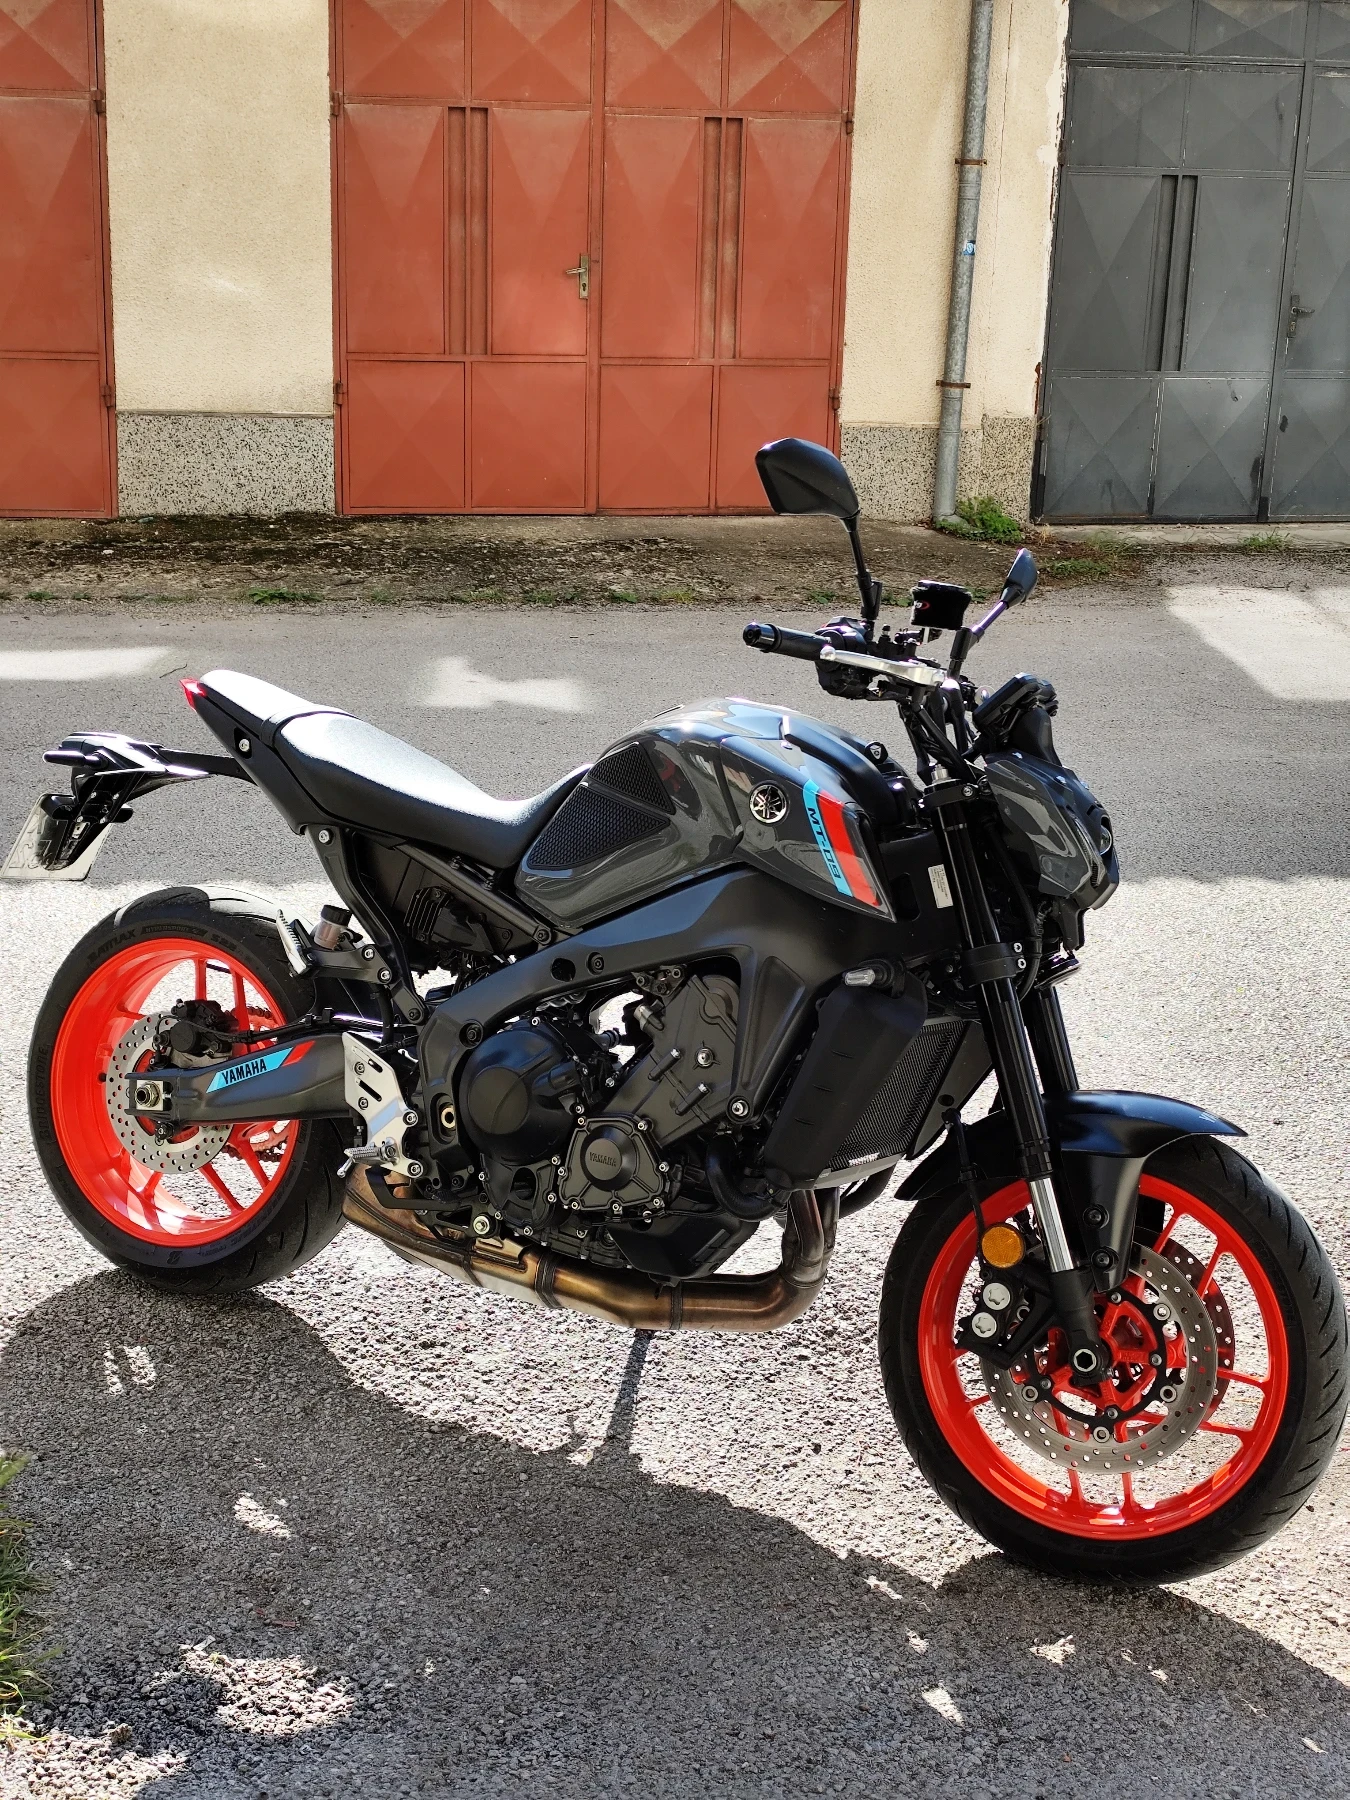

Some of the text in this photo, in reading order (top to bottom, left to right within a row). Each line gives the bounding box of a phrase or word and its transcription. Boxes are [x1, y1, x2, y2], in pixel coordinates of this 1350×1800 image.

[807, 807, 841, 879] MT-09
[221, 1058, 267, 1085] YAMAHA
[589, 1151, 617, 1167] YAMAHA
